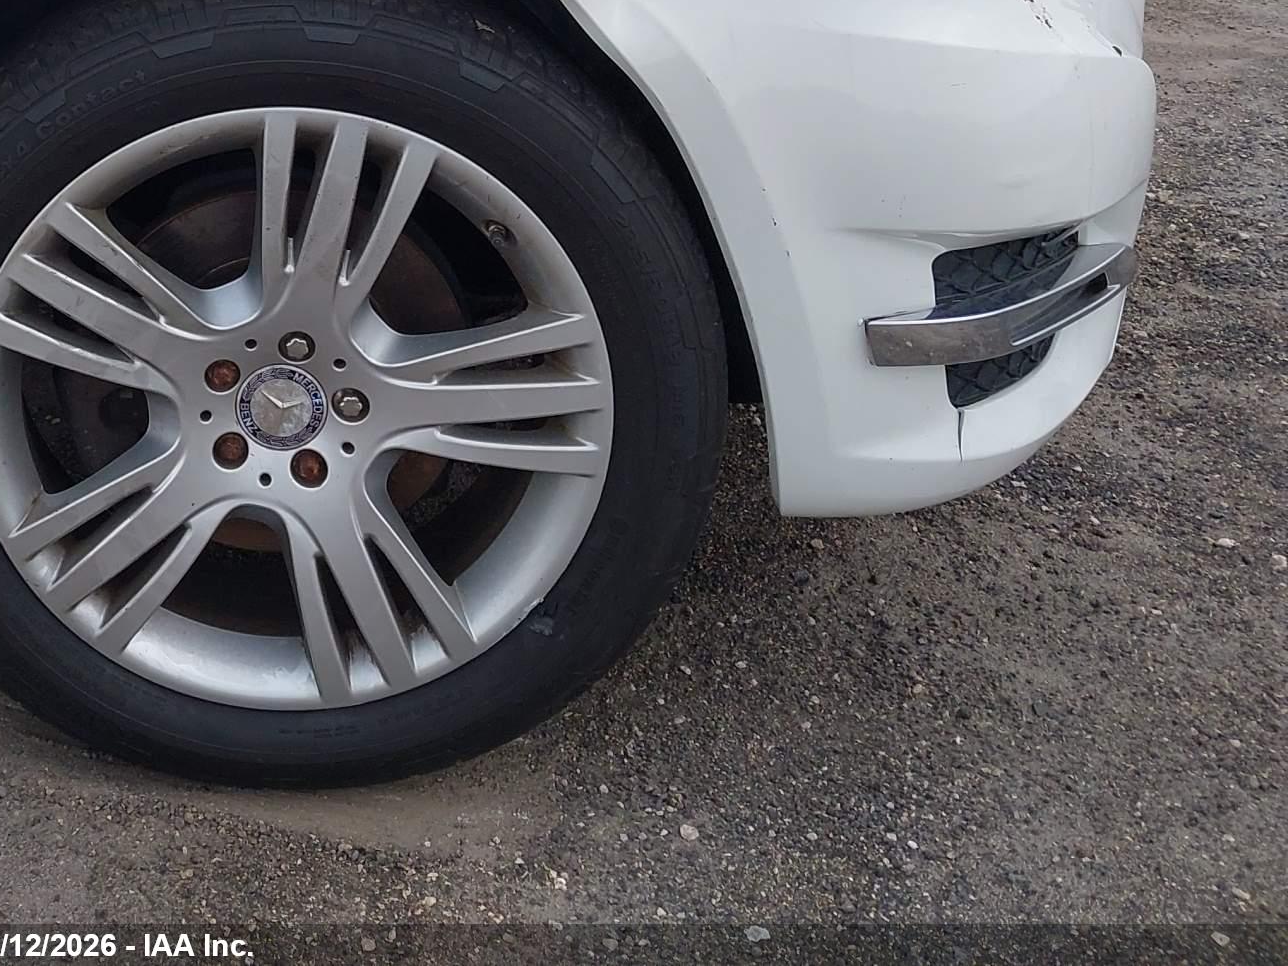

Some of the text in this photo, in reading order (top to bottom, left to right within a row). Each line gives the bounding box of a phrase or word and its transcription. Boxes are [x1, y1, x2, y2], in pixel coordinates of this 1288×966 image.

[35, 68, 146, 138] Contact
[240, 403, 261, 434] BENZ
[292, 372, 323, 431] MERCEDES
